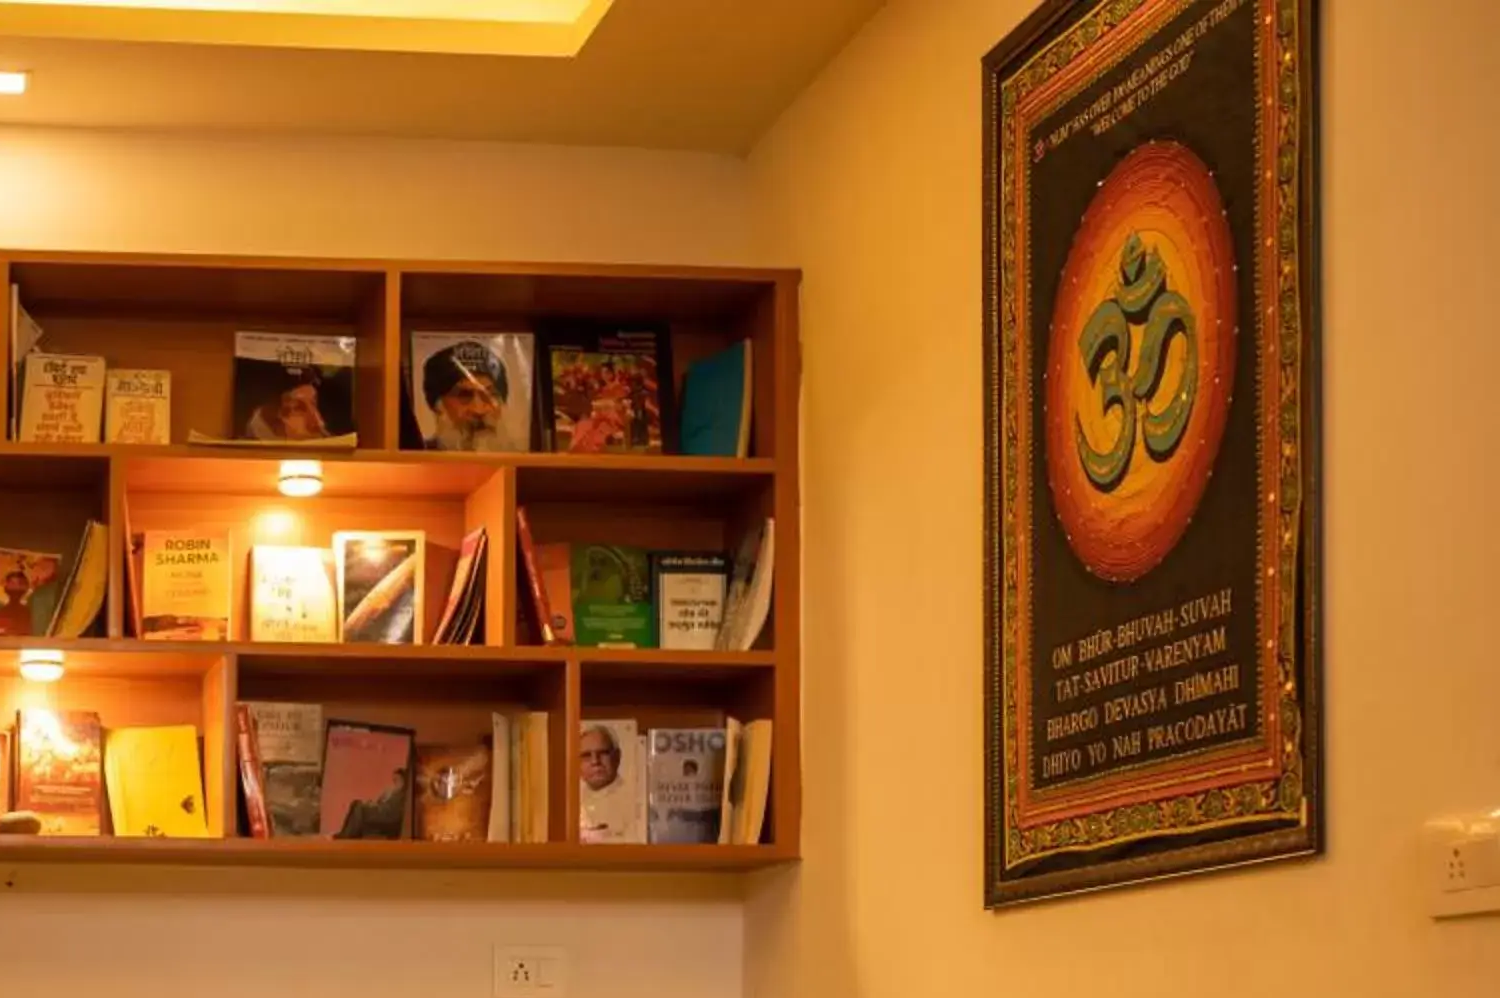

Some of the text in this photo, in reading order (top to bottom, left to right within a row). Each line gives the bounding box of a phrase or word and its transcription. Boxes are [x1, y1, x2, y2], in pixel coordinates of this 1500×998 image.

[165, 538, 211, 551] ROBIN
[156, 552, 219, 566] SHARMA
[1053, 643, 1073, 670] OM
[1047, 706, 1099, 741] BHARGO
[1104, 687, 1168, 724] DEVASYA
[655, 732, 725, 754] OSHO
[1042, 749, 1081, 779] DHIYO
[1088, 742, 1107, 766] YO
[1112, 730, 1141, 759] NAH
